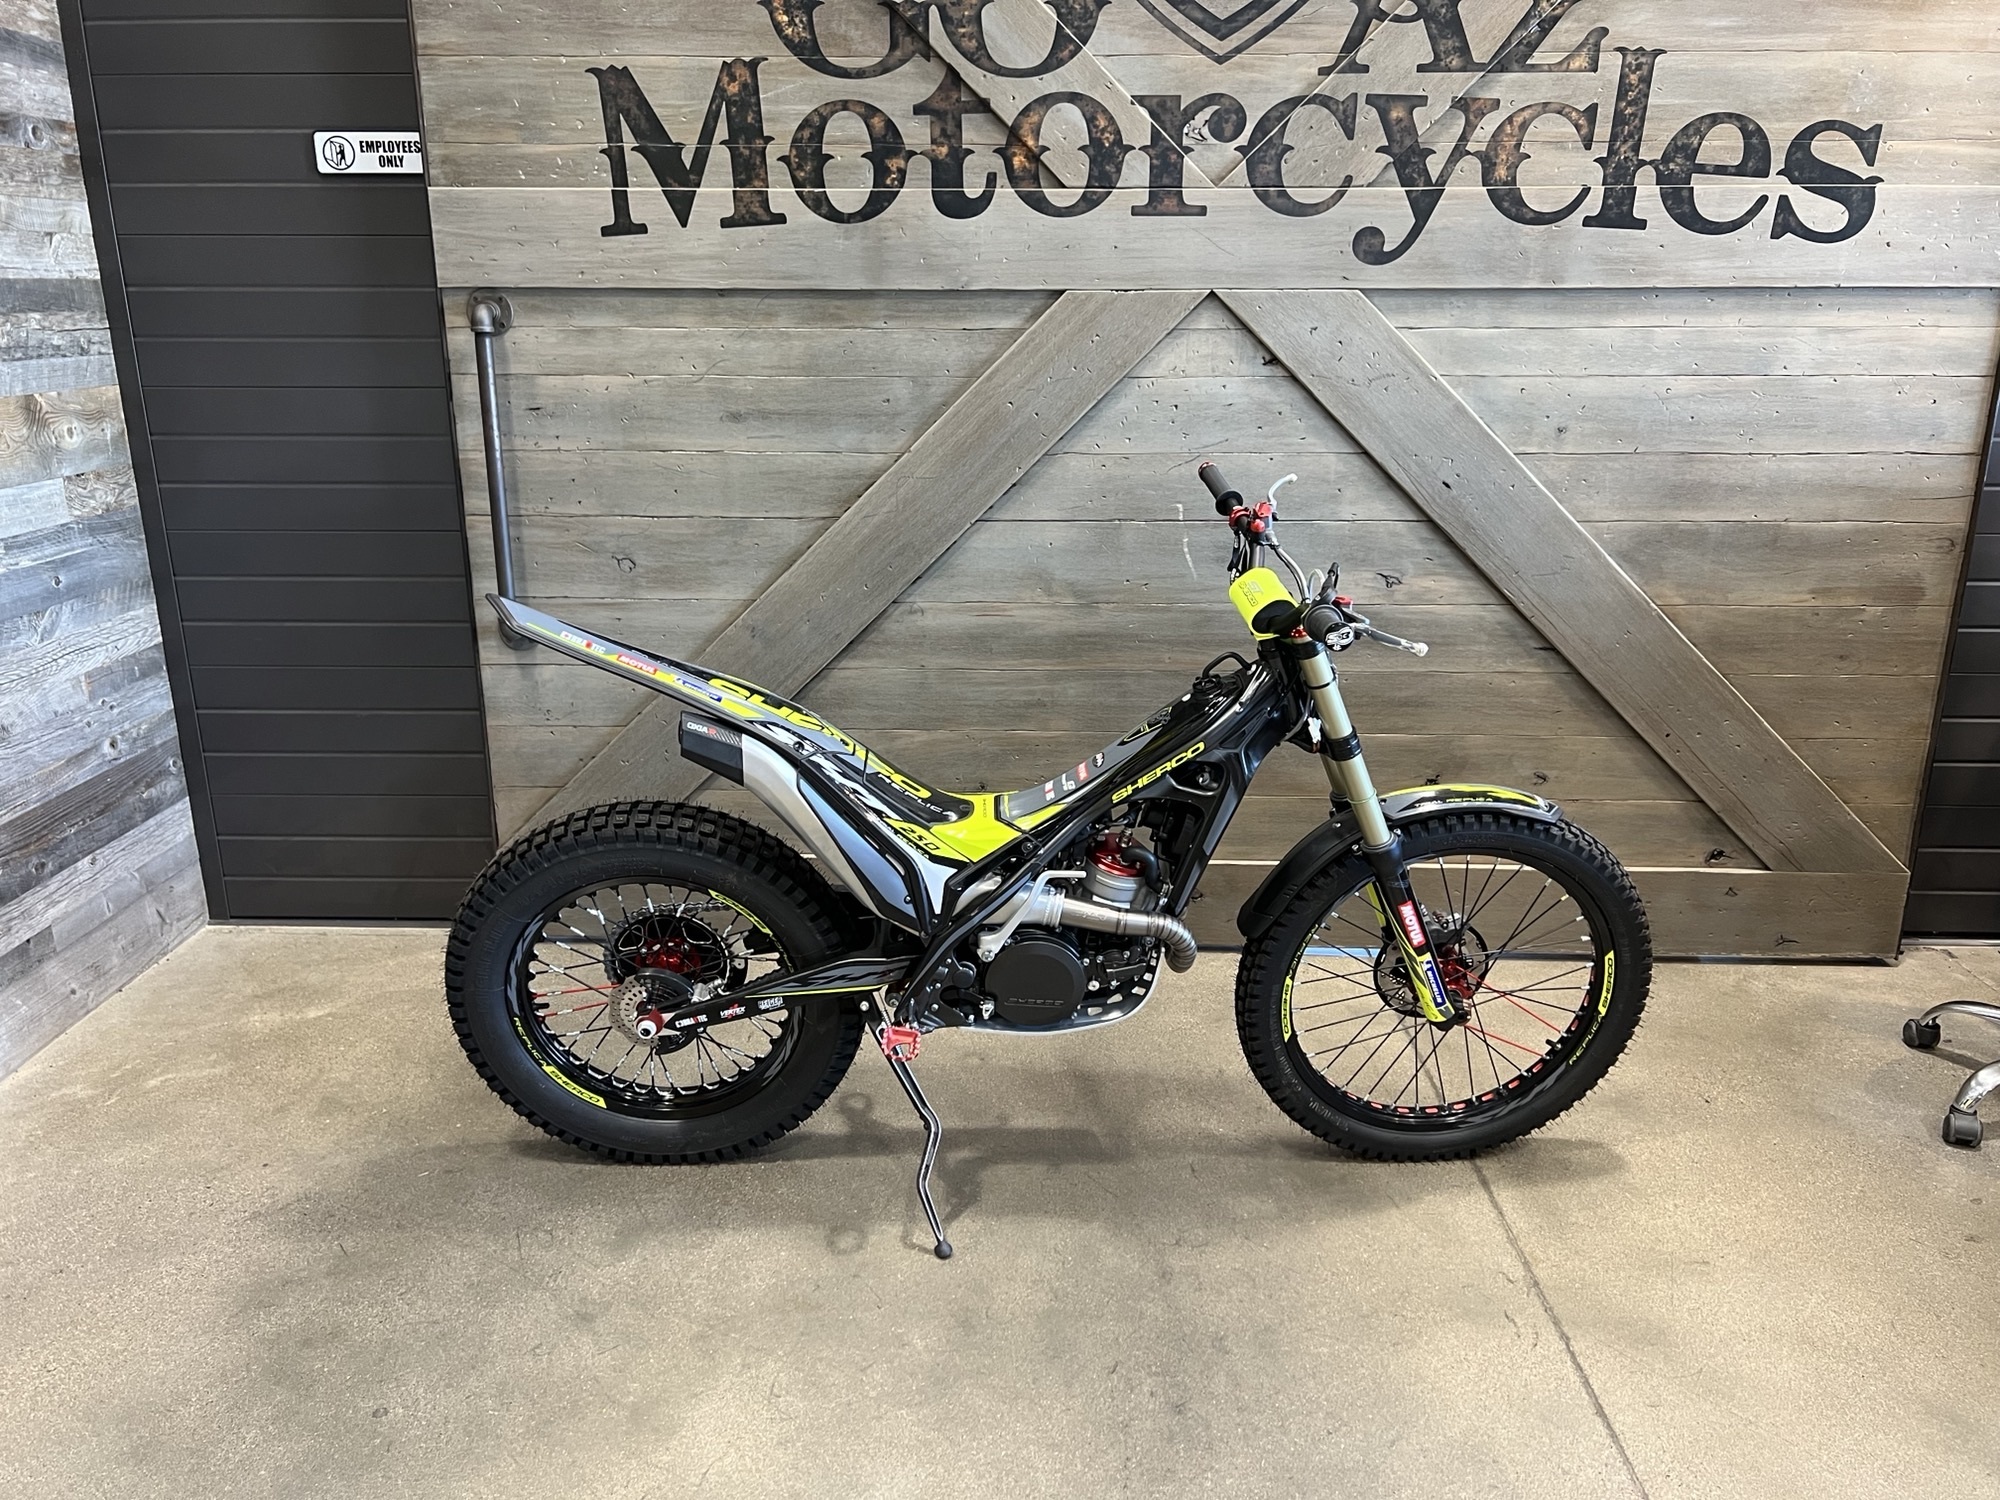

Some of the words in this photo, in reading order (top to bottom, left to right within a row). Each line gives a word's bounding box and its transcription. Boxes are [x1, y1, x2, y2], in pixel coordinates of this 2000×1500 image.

[359, 140, 421, 153] EMPLOYEES
[378, 155, 404, 168] ONLY
[585, 47, 1884, 266] Motorcycles
[619, 655, 655, 675] MOTUL
[1111, 741, 1205, 804] SHERCO
[900, 827, 941, 851] 250
[1400, 904, 1422, 946] MOTUL
[1426, 970, 1443, 1003] MICHELIN
[1602, 957, 1613, 1009] SHERCO
[513, 1017, 547, 1067] REPLICA
[1568, 1013, 1603, 1066] REPLICA
[549, 1070, 600, 1103] SHERCO
